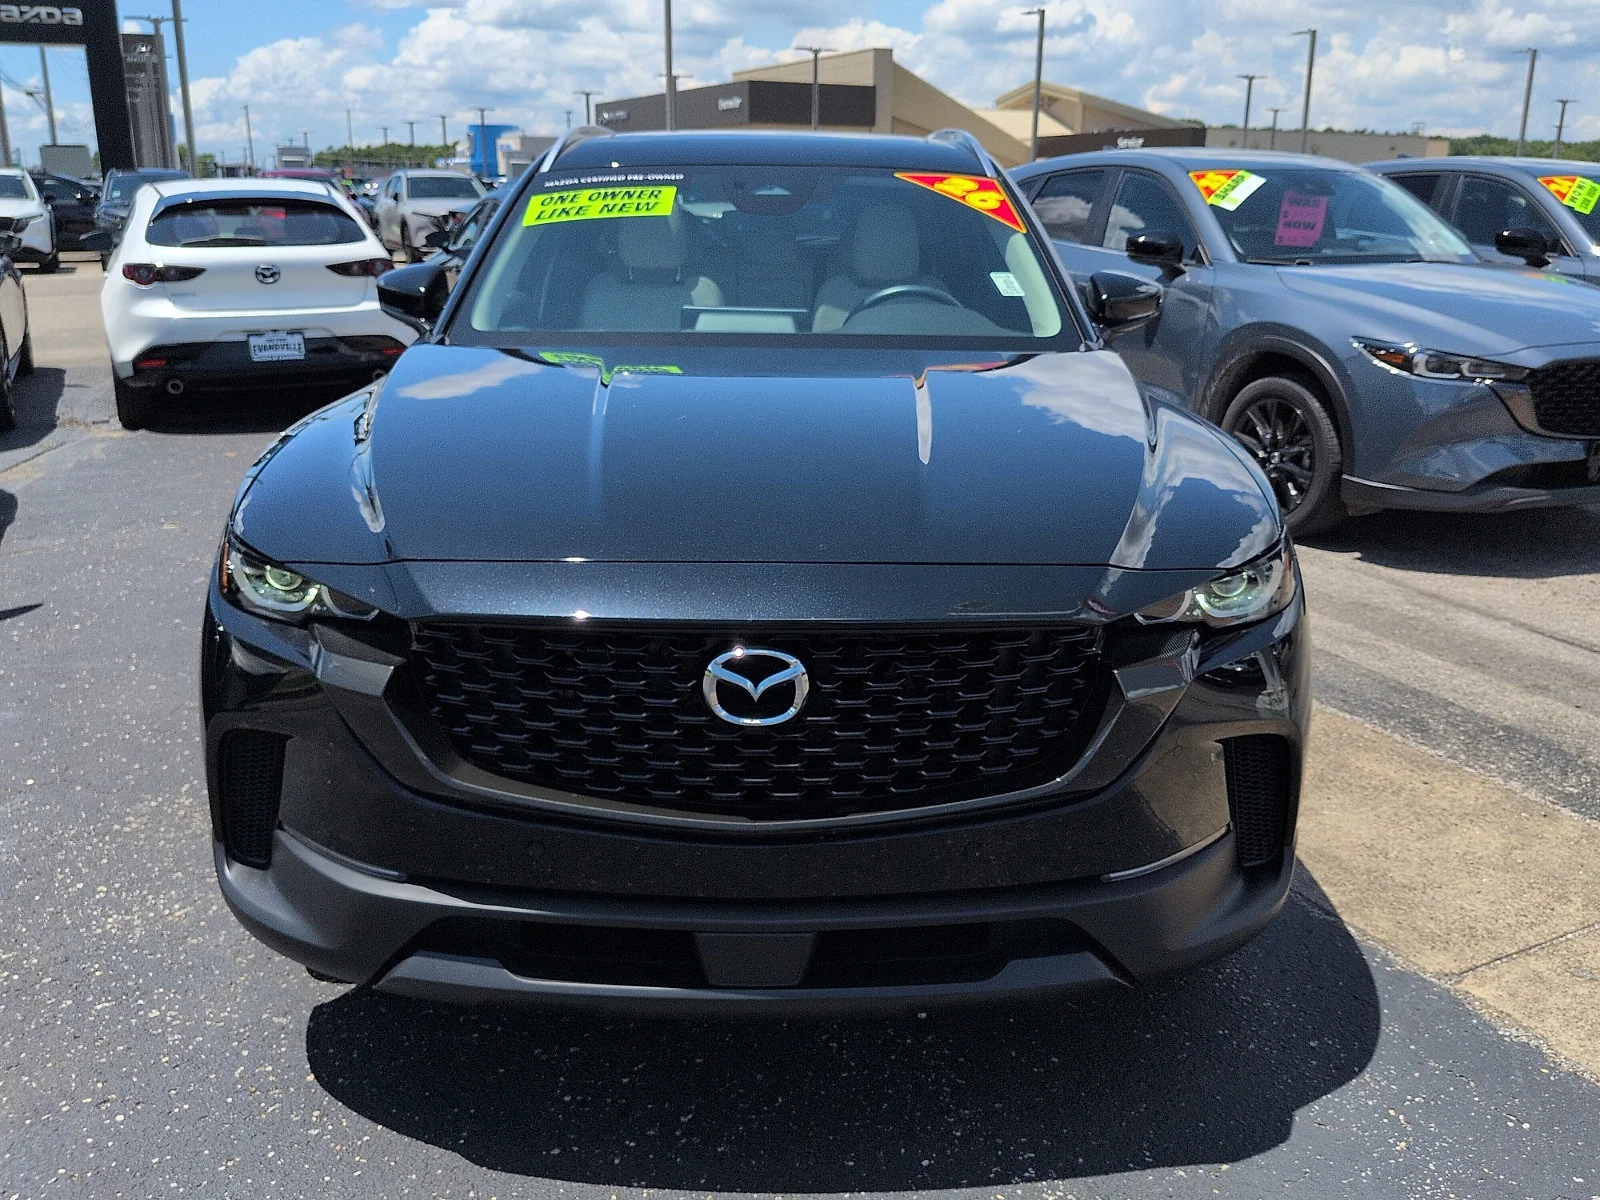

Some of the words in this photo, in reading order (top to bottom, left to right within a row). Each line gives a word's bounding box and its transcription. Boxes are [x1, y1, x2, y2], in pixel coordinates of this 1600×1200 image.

[0, 5, 83, 26] azda
[541, 192, 581, 207] ONE
[588, 189, 662, 203] OWNER
[534, 204, 591, 221] LIKE
[598, 201, 659, 215] NEW
[1283, 220, 1316, 231] NOW
